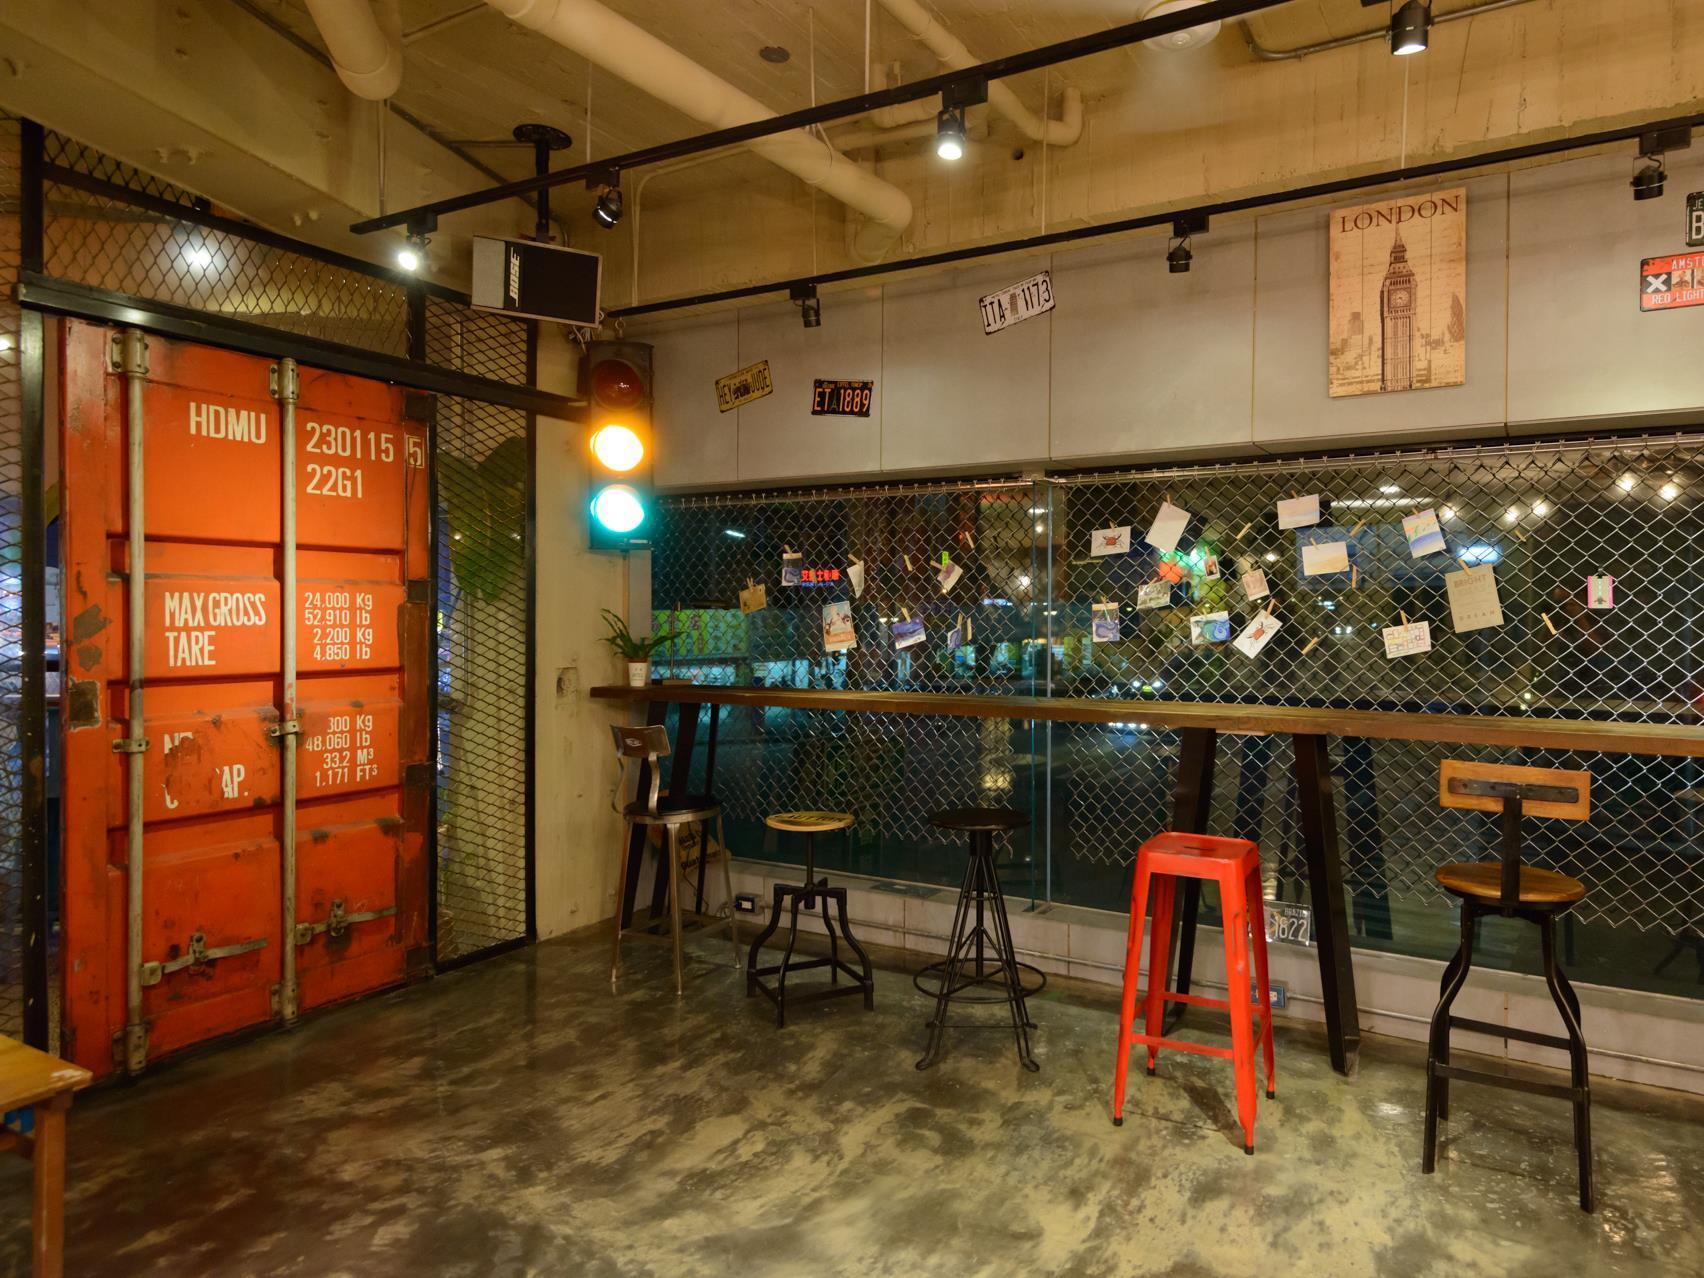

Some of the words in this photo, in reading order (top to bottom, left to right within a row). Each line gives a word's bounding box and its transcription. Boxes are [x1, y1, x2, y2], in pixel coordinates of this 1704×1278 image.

[1340, 195, 1460, 233] LONDON
[509, 246, 520, 308] BOSE
[982, 298, 1006, 328] ITA
[1021, 279, 1051, 311] 1173
[1652, 293, 1671, 304] RED
[718, 382, 734, 406] HEY
[750, 368, 770, 394] JUDE
[814, 388, 832, 411] ET
[839, 389, 870, 412] 1889
[189, 402, 267, 444] HDMU
[306, 422, 394, 463] 230115
[407, 436, 423, 467] 5
[306, 464, 363, 498] 22G1
[165, 592, 205, 628] MAX
[208, 592, 266, 626] GROSS
[304, 592, 350, 608] 24,000
[356, 592, 373, 610] Kg
[304, 609, 350, 625] 52,910
[356, 609, 370, 625] lb
[313, 627, 350, 644] 2,200
[356, 627, 373, 645] Kg
[165, 631, 217, 667] TARE
[313, 644, 350, 661] 4,850
[356, 644, 371, 660] lb
[356, 714, 373, 731] Kg
[305, 733, 350, 751] 48,060
[356, 731, 371, 747] lb
[323, 751, 350, 769] 33.2
[315, 767, 348, 787] 1,171
